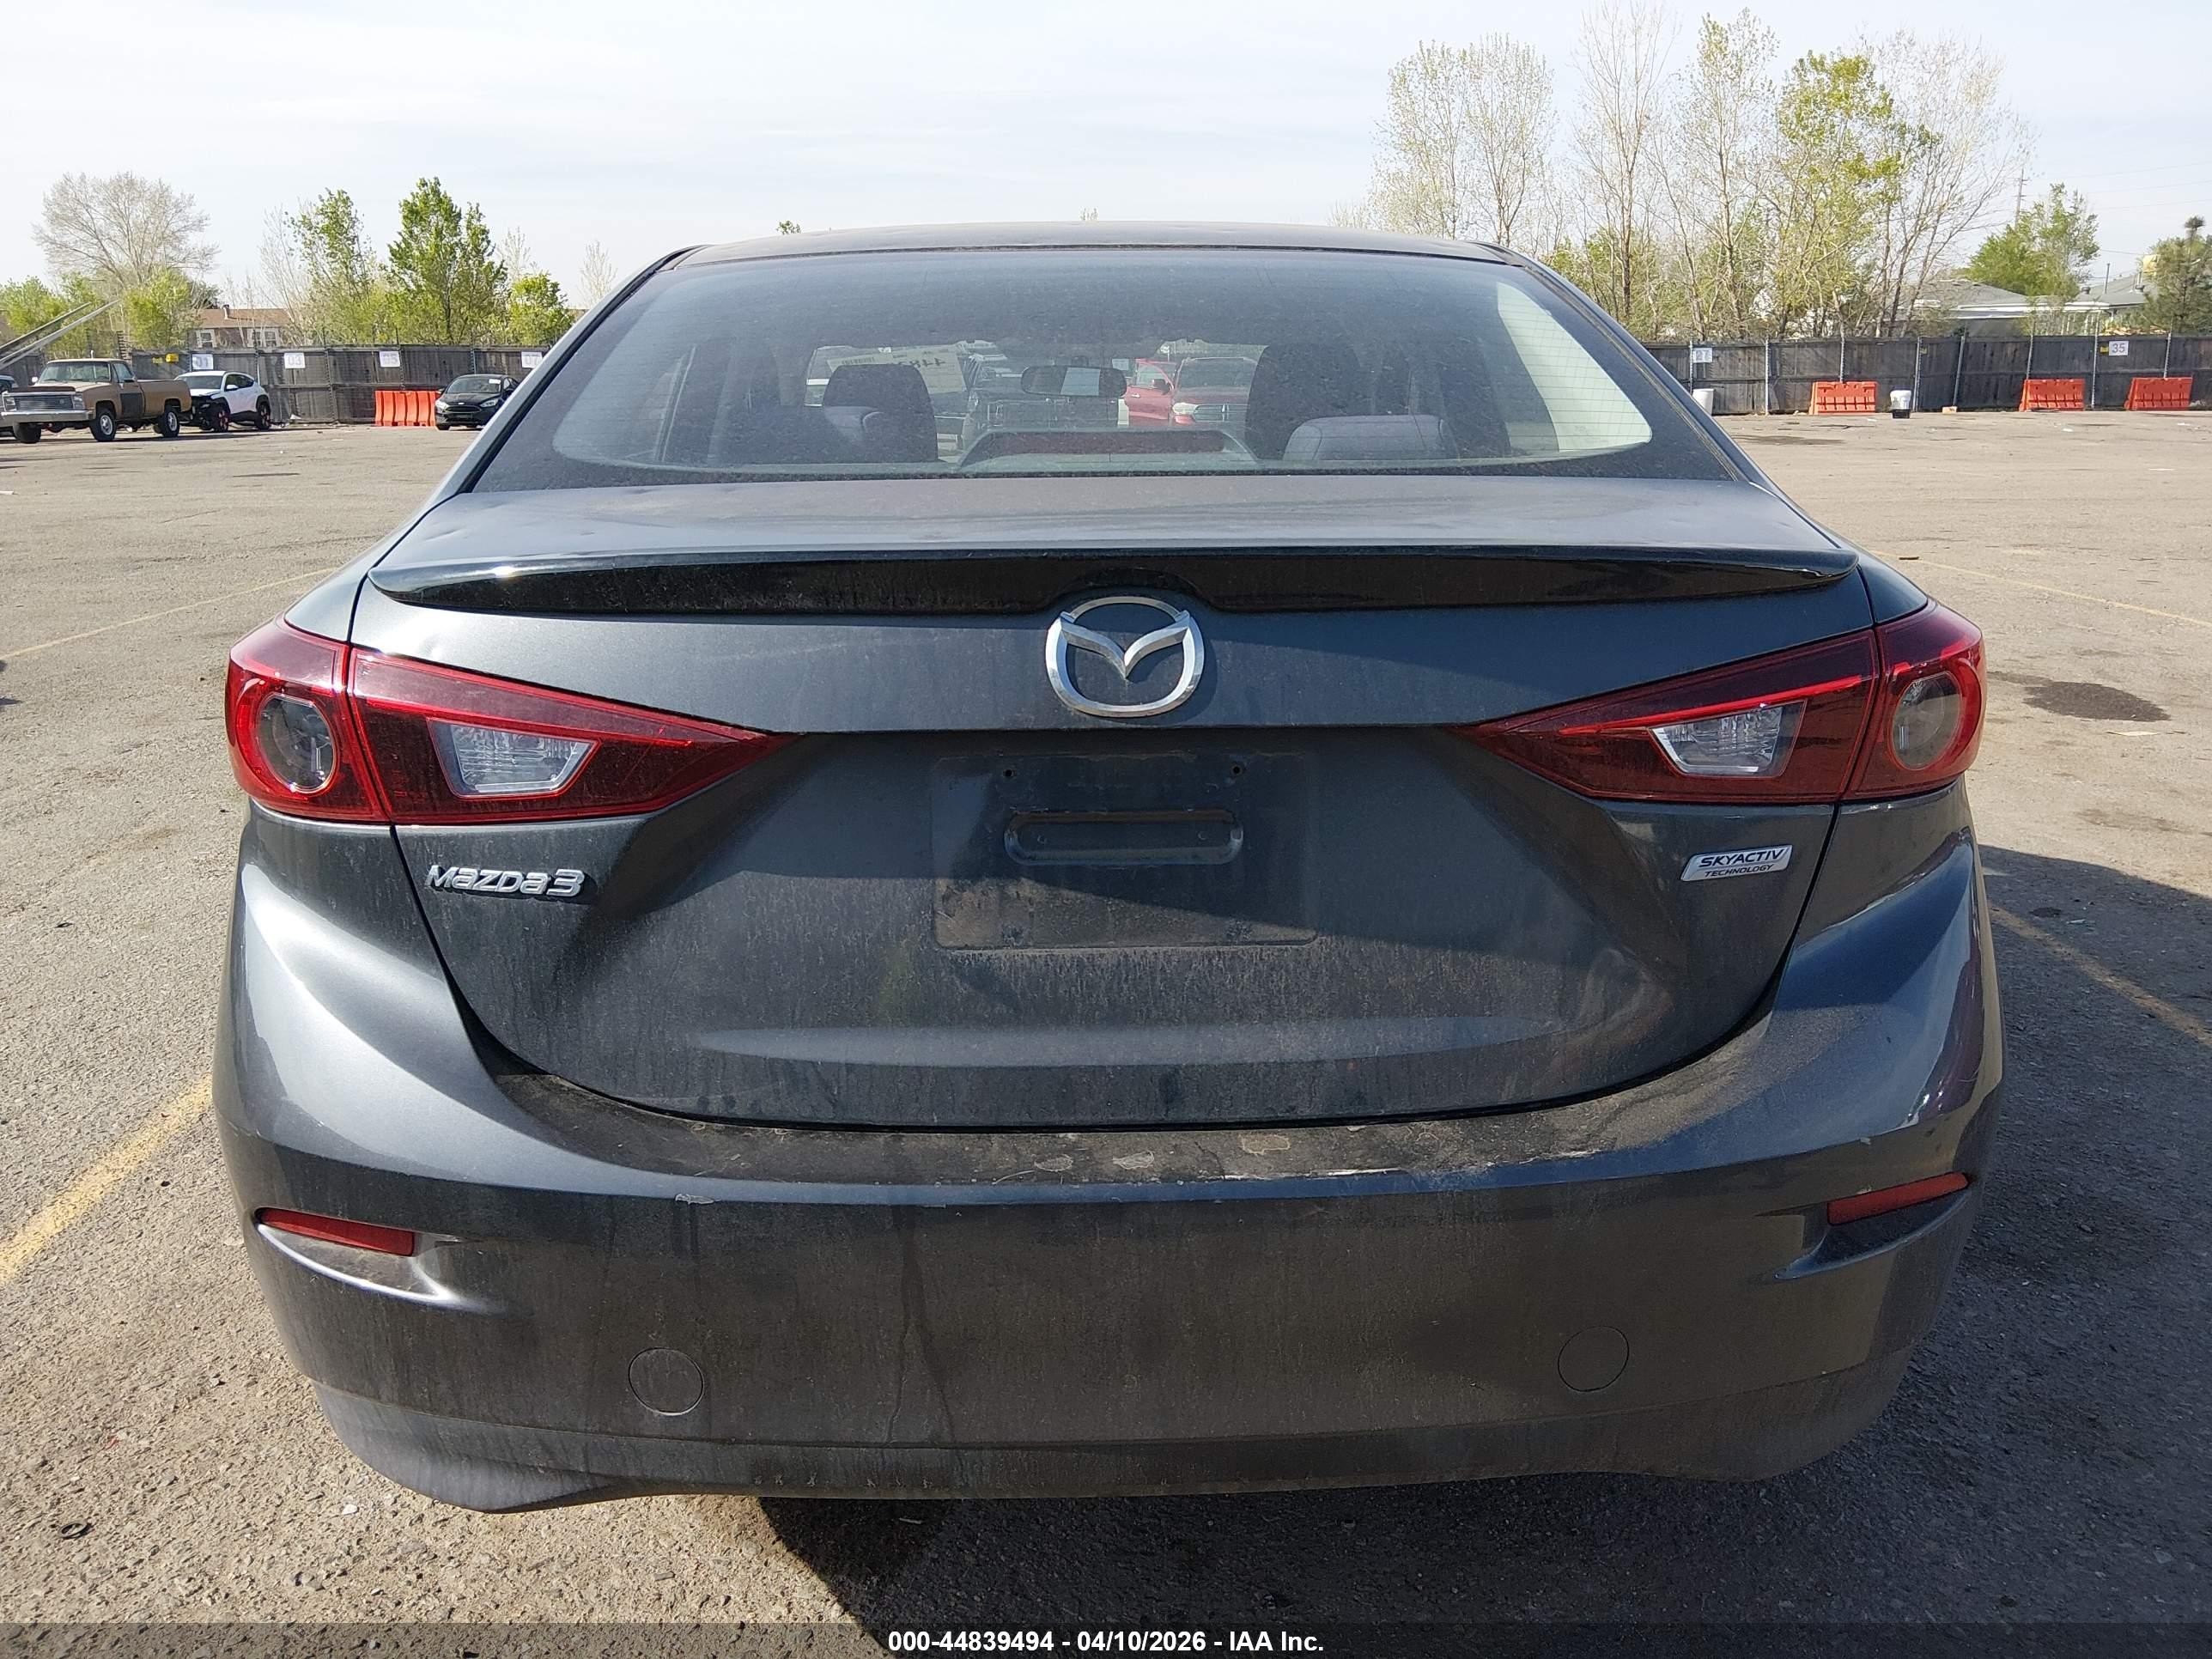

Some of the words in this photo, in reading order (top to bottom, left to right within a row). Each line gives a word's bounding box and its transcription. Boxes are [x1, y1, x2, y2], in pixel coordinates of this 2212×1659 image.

[2112, 343, 2125, 353] 35
[194, 356, 209, 368] 01
[288, 354, 301, 366] 03
[1699, 848, 1784, 867] SKYACTIV
[1705, 864, 1774, 878] TECHNOLOGY
